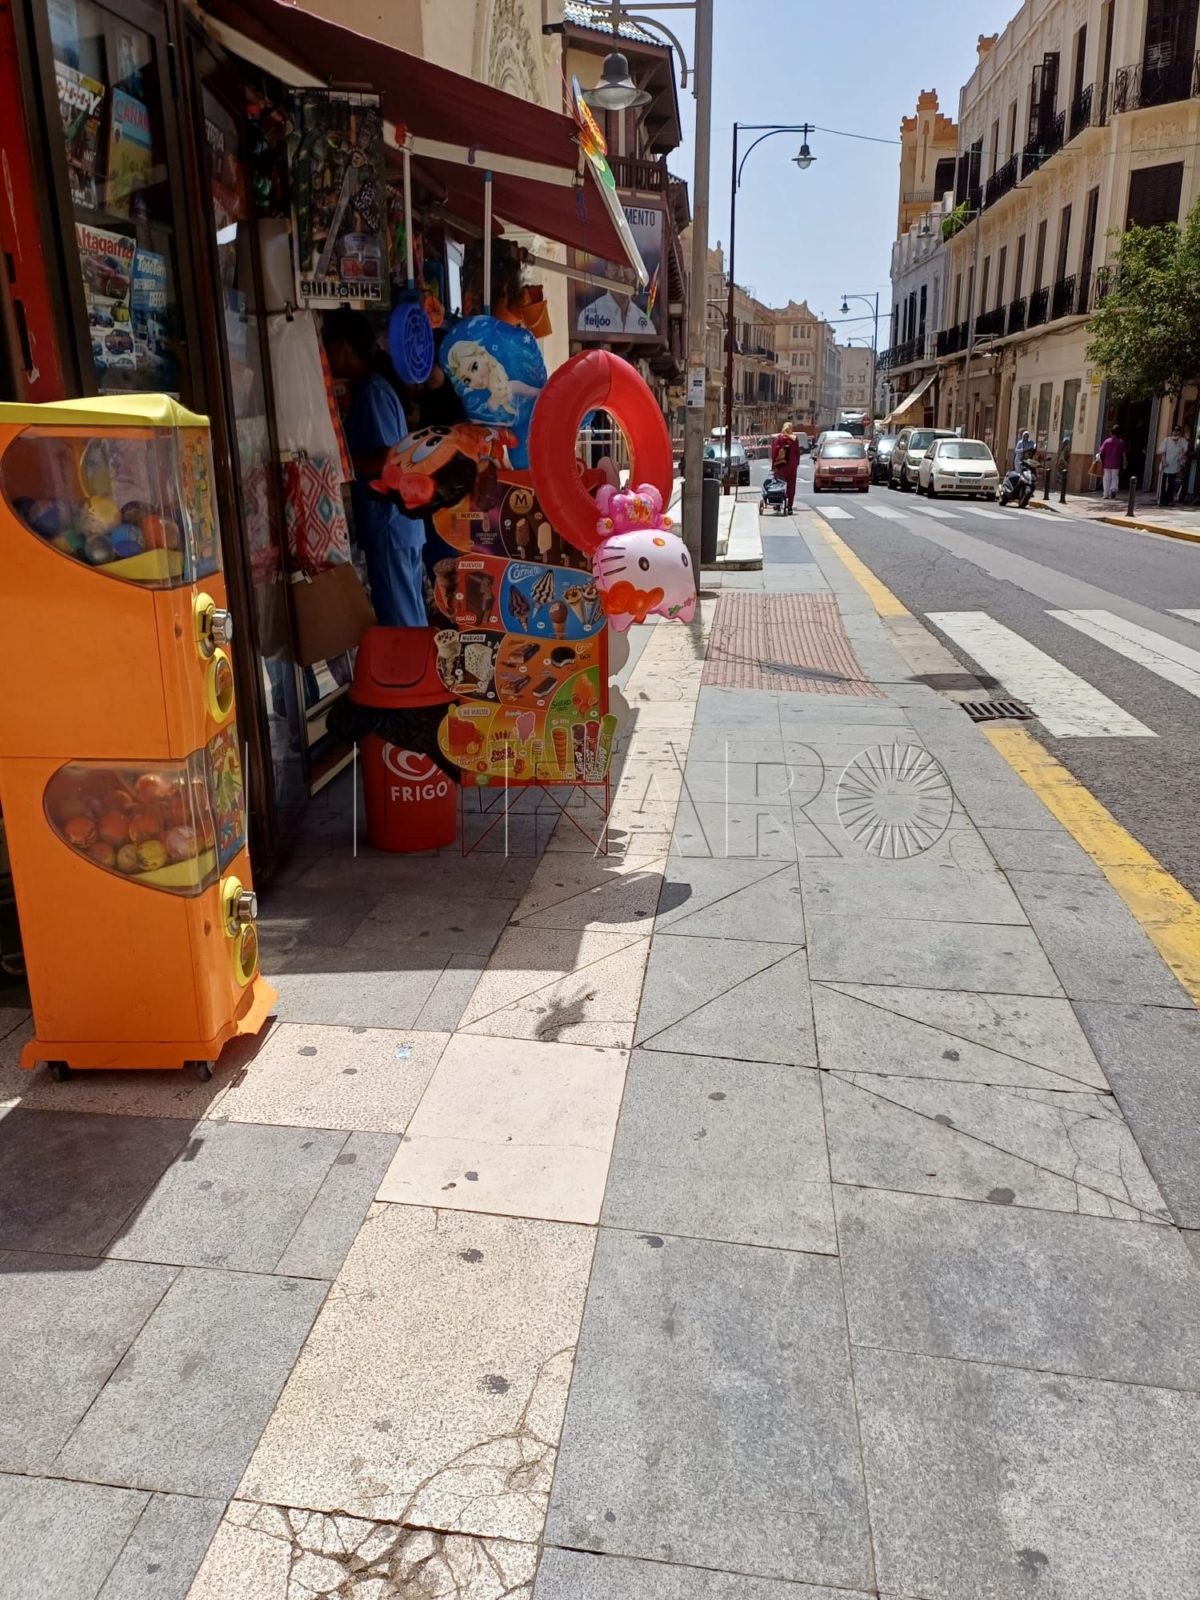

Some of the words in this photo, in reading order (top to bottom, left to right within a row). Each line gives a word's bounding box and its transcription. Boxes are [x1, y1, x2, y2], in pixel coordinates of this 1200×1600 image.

[622, 207, 655, 226] MENTO
[585, 314, 611, 328] feijóo
[390, 781, 448, 802] FRIGO
